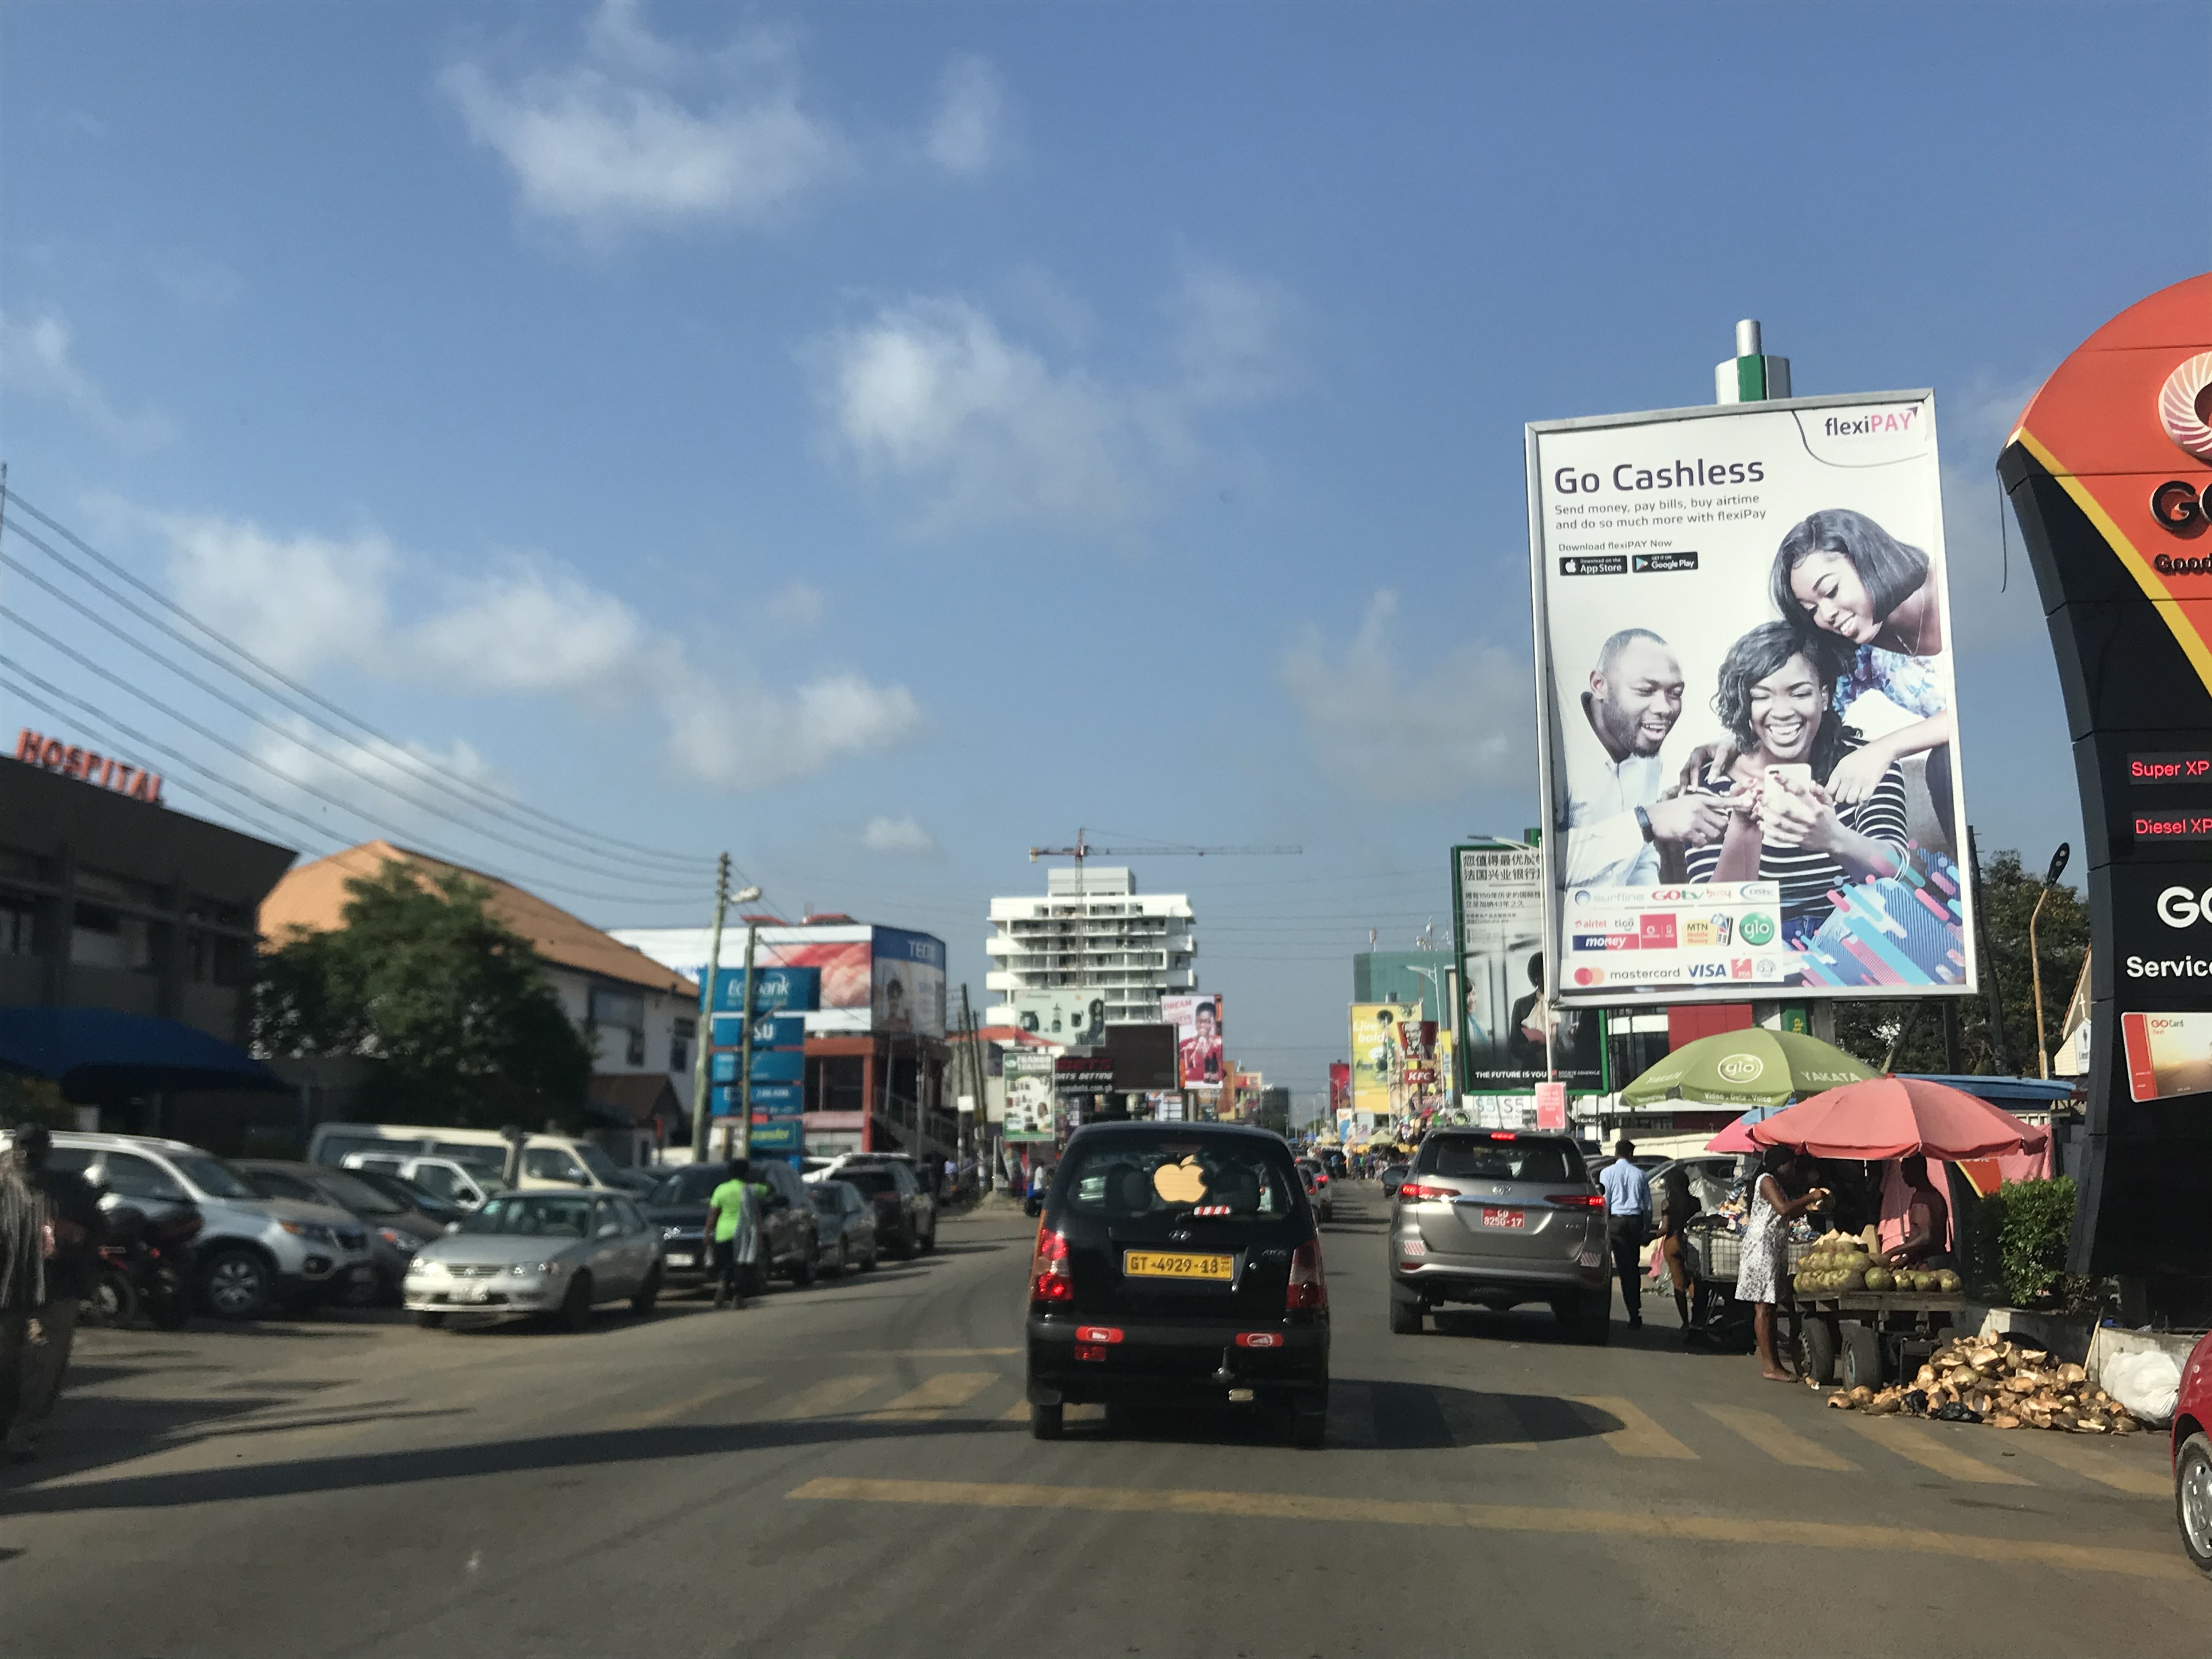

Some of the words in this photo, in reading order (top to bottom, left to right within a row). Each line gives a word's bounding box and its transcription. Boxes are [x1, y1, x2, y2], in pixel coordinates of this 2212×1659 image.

[1825, 412, 1911, 436] flexiPAY
[1554, 467, 1600, 494] Go
[1612, 458, 1764, 491] Cashless
[1555, 504, 1584, 515] Send
[1588, 503, 1630, 514] money,
[1634, 501, 1655, 513] pay
[1659, 498, 1687, 510] bills,
[1691, 497, 1712, 509] buy
[1716, 494, 1759, 506] airtime
[2149, 481, 2212, 531] G
[1555, 518, 1577, 530] and
[1581, 518, 1595, 529] do
[1599, 520, 1613, 528] so
[1617, 515, 1649, 527] much
[1652, 516, 1683, 526] more
[1687, 512, 1713, 524] with
[1717, 509, 1767, 521] flexiPay
[1559, 543, 1606, 552] Download
[1607, 540, 1647, 550] flexiPAY
[1650, 539, 1673, 548] Now
[1580, 564, 1598, 574] App
[1599, 563, 1622, 573] Store
[1651, 560, 1679, 570] Google
[1679, 558, 1695, 568] Play
[2131, 760, 2181, 780] Super
[2185, 759, 2210, 776] XP
[2135, 819, 2187, 834] Diesel
[2191, 817, 2212, 834] XP
[1464, 868, 1541, 881] 法国兴业银行
[2157, 886, 2212, 928] G
[1583, 919, 1607, 929] airtel
[1744, 920, 1769, 940] glo
[1585, 935, 1627, 948] money
[1610, 968, 1680, 980] mastercard
[1686, 963, 1727, 978] VISA
[1408, 1071, 1431, 1081] KFC
[1522, 1070, 1530, 1079] IS
[1530, 1070, 1547, 1079] YOU
[1725, 1061, 1756, 1076] glo
[1799, 1070, 1864, 1082] YAKATA
